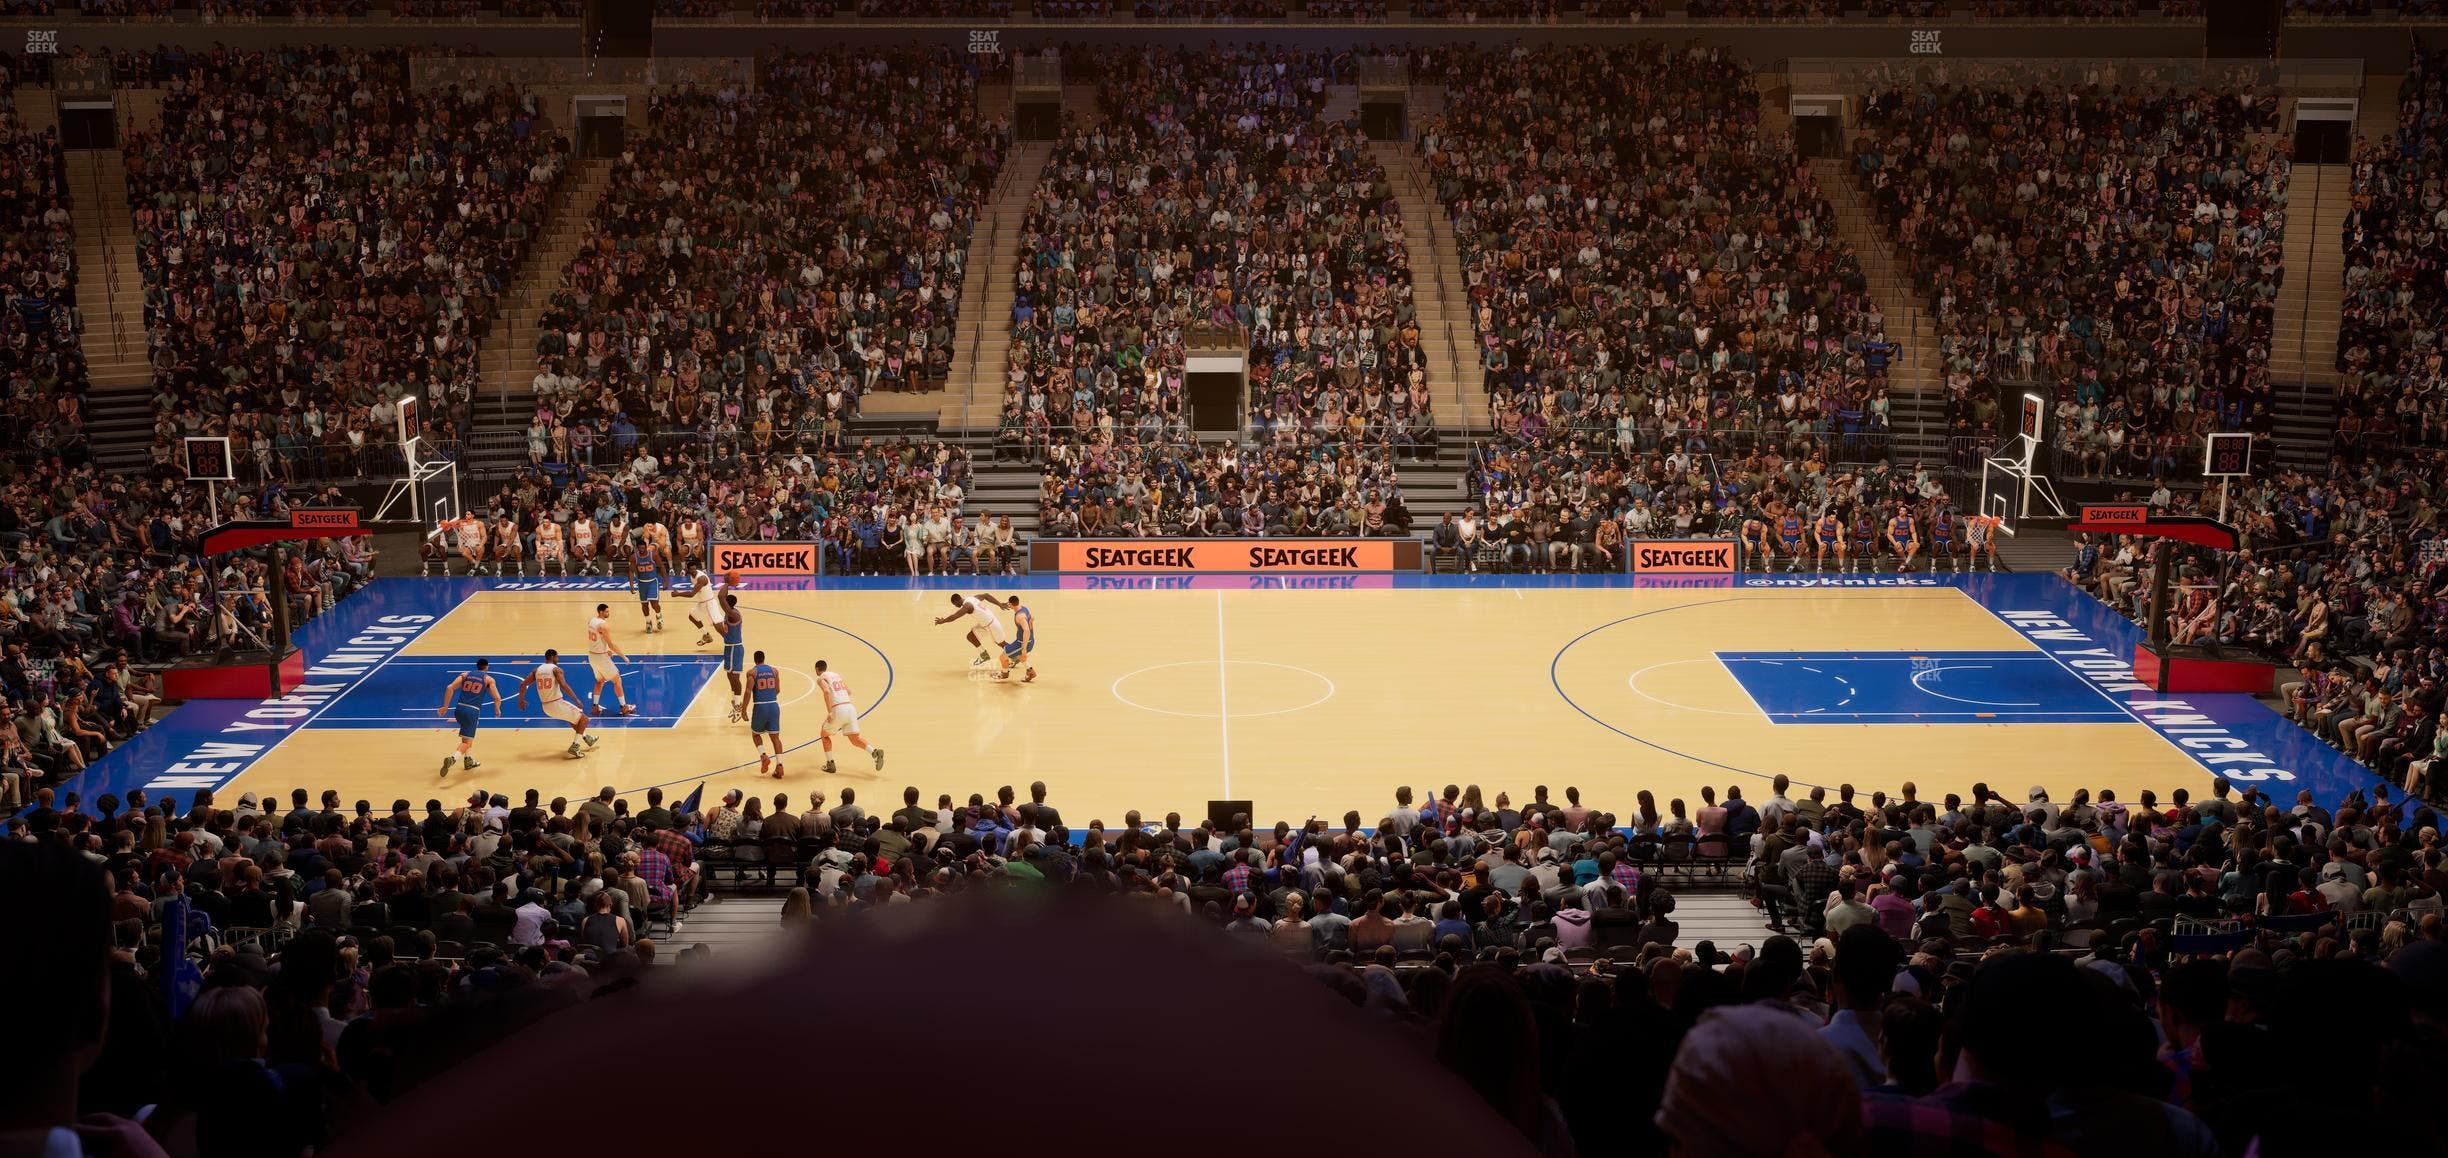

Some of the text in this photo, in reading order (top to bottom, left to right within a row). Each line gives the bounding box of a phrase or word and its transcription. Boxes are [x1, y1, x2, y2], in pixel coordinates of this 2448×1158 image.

[297, 513, 351, 525] SEATGEEK
[2089, 509, 2139, 521] SEATGEEK
[720, 550, 810, 571] SEATGEEK
[1086, 546, 1359, 569] SEATGEEK SEATGEEK
[1640, 548, 1729, 569] SEATGEEK
[1745, 577, 1937, 588] @nyknicks
[1998, 610, 2094, 642] NEW
[303, 614, 436, 676] KNICKS
[2054, 647, 2155, 693] YORK
[220, 682, 348, 733] YORK
[2123, 700, 2297, 782] KNICKS
[142, 742, 266, 789] NEW
